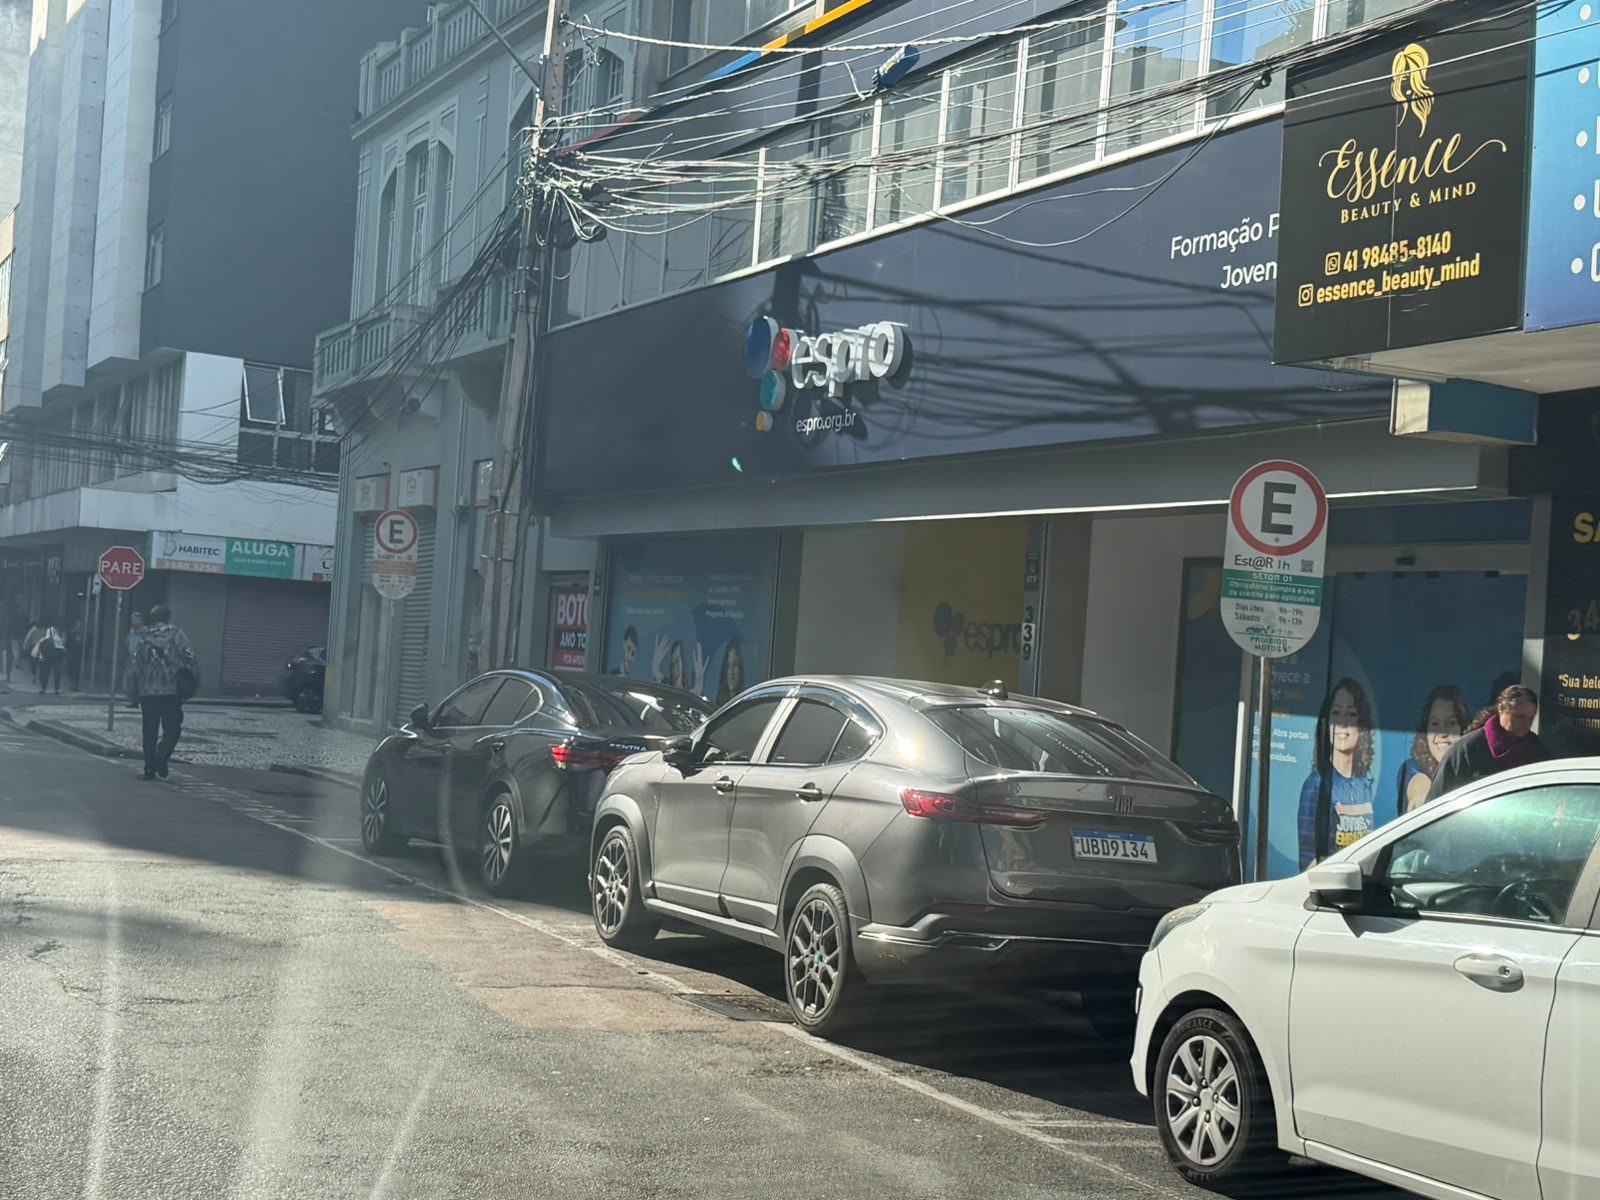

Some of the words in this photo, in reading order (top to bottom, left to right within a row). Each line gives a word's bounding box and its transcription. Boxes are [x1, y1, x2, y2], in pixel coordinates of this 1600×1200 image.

[1318, 133, 1507, 203] Essence
[1340, 198, 1402, 224] BEAUTY
[1409, 192, 1422, 209] &
[1428, 181, 1478, 205] MIND
[1170, 216, 1264, 260] Formação
[1343, 249, 1359, 273] 41
[1362, 230, 1452, 270] 98485-8140
[1316, 252, 1481, 304] essence_beauty_mind
[791, 321, 904, 397] espro
[796, 409, 857, 436] espro.org.br
[1261, 481, 1297, 535] E
[178, 545, 220, 556] HABITEC
[231, 541, 290, 558] ALUGA
[389, 519, 404, 544] E
[101, 560, 141, 575] PARE
[1234, 553, 1273, 570] Est@R
